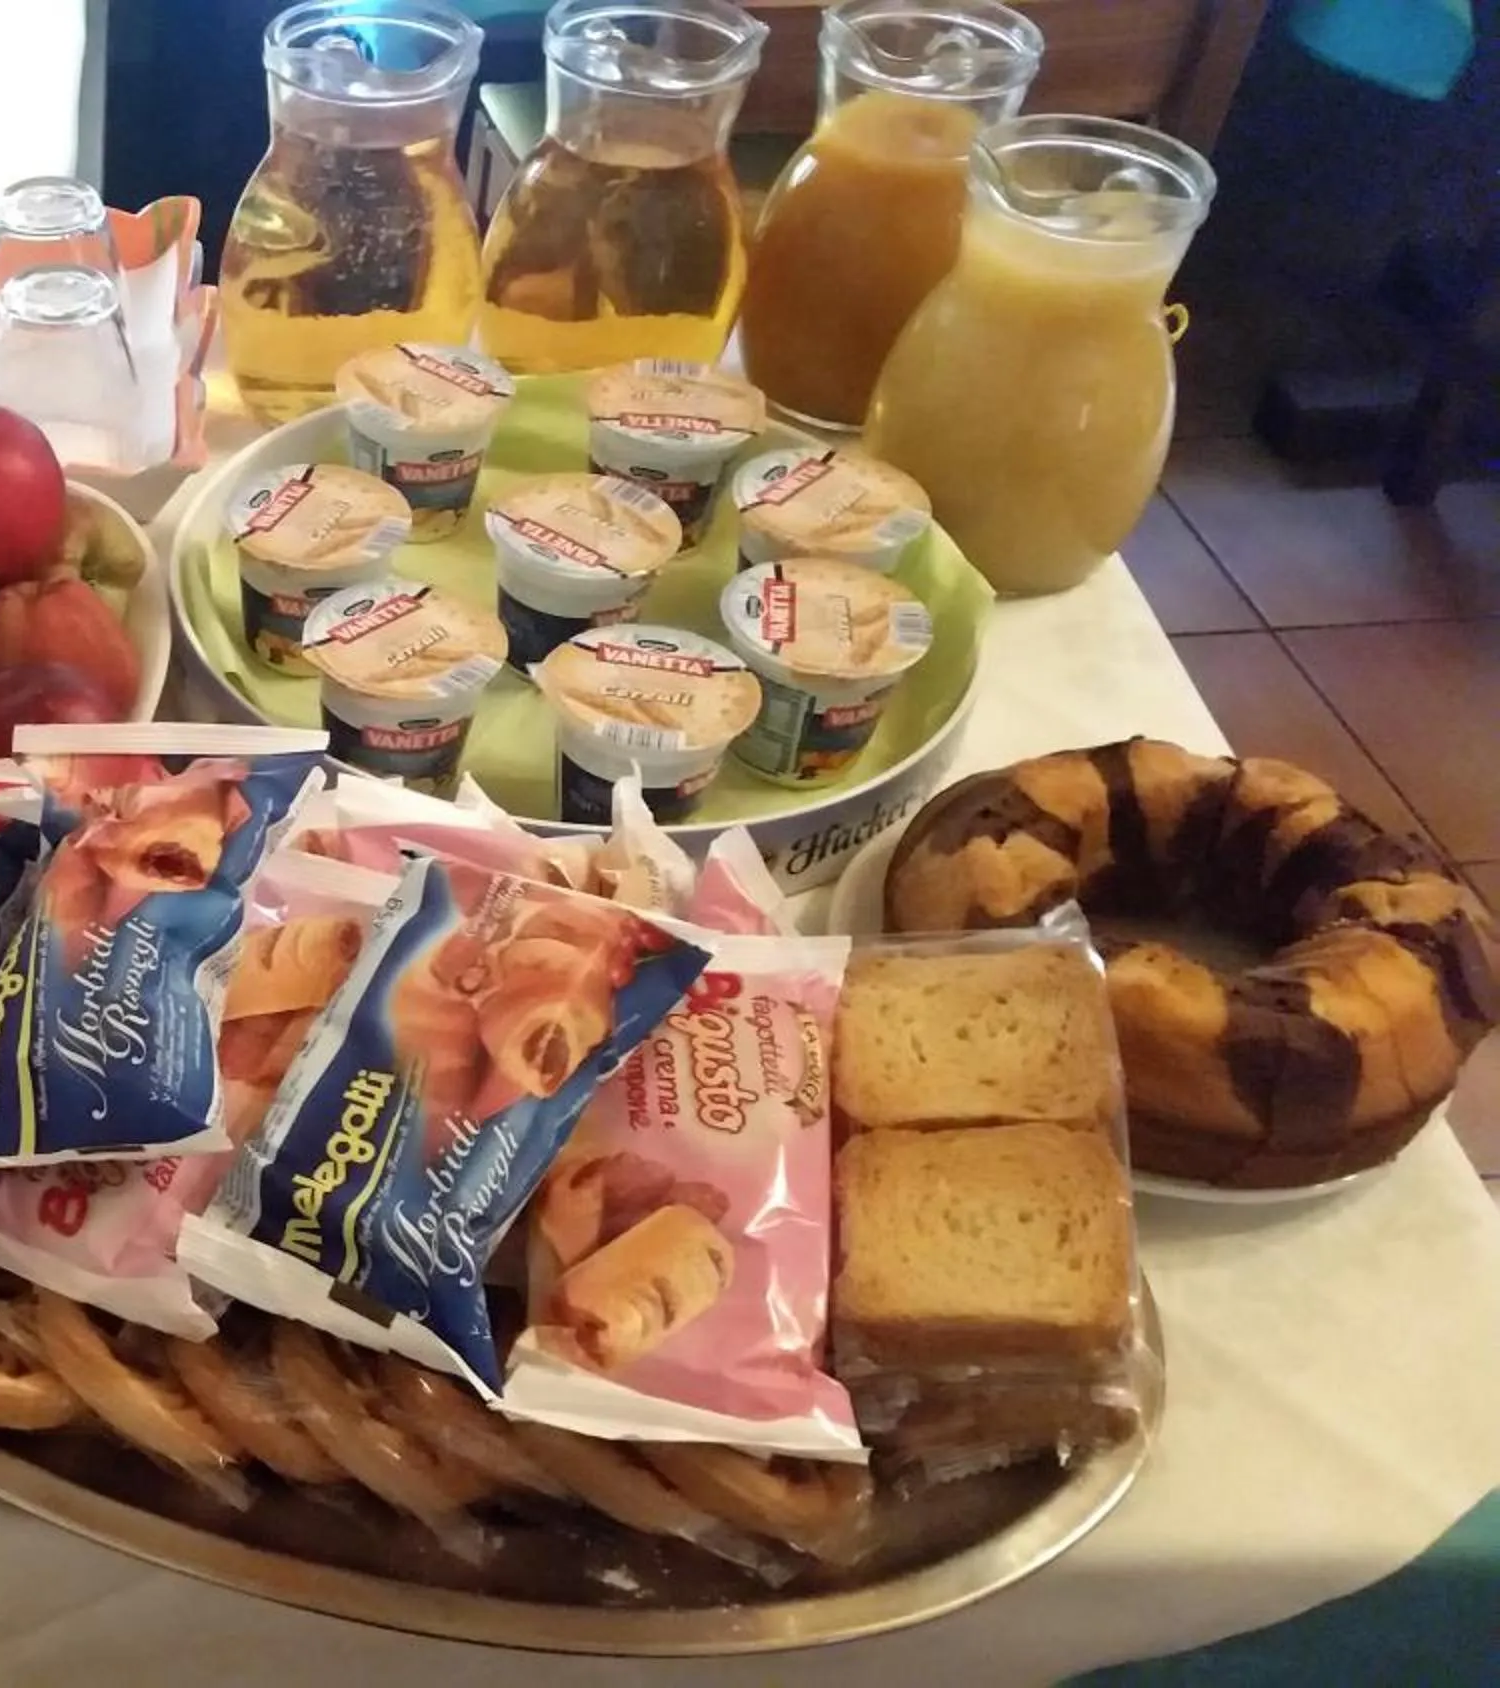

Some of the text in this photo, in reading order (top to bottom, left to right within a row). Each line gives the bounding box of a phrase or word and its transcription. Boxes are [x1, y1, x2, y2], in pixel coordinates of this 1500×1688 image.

[334, 599, 416, 642] VANETTA
[603, 647, 706, 676] VANETTA
[52, 922, 117, 1120] Morbidi
[101, 916, 158, 1066] Risvegli
[653, 1037, 680, 1116] crema
[381, 1109, 481, 1322] Morbidi
[432, 1121, 520, 1288] Risvegli
